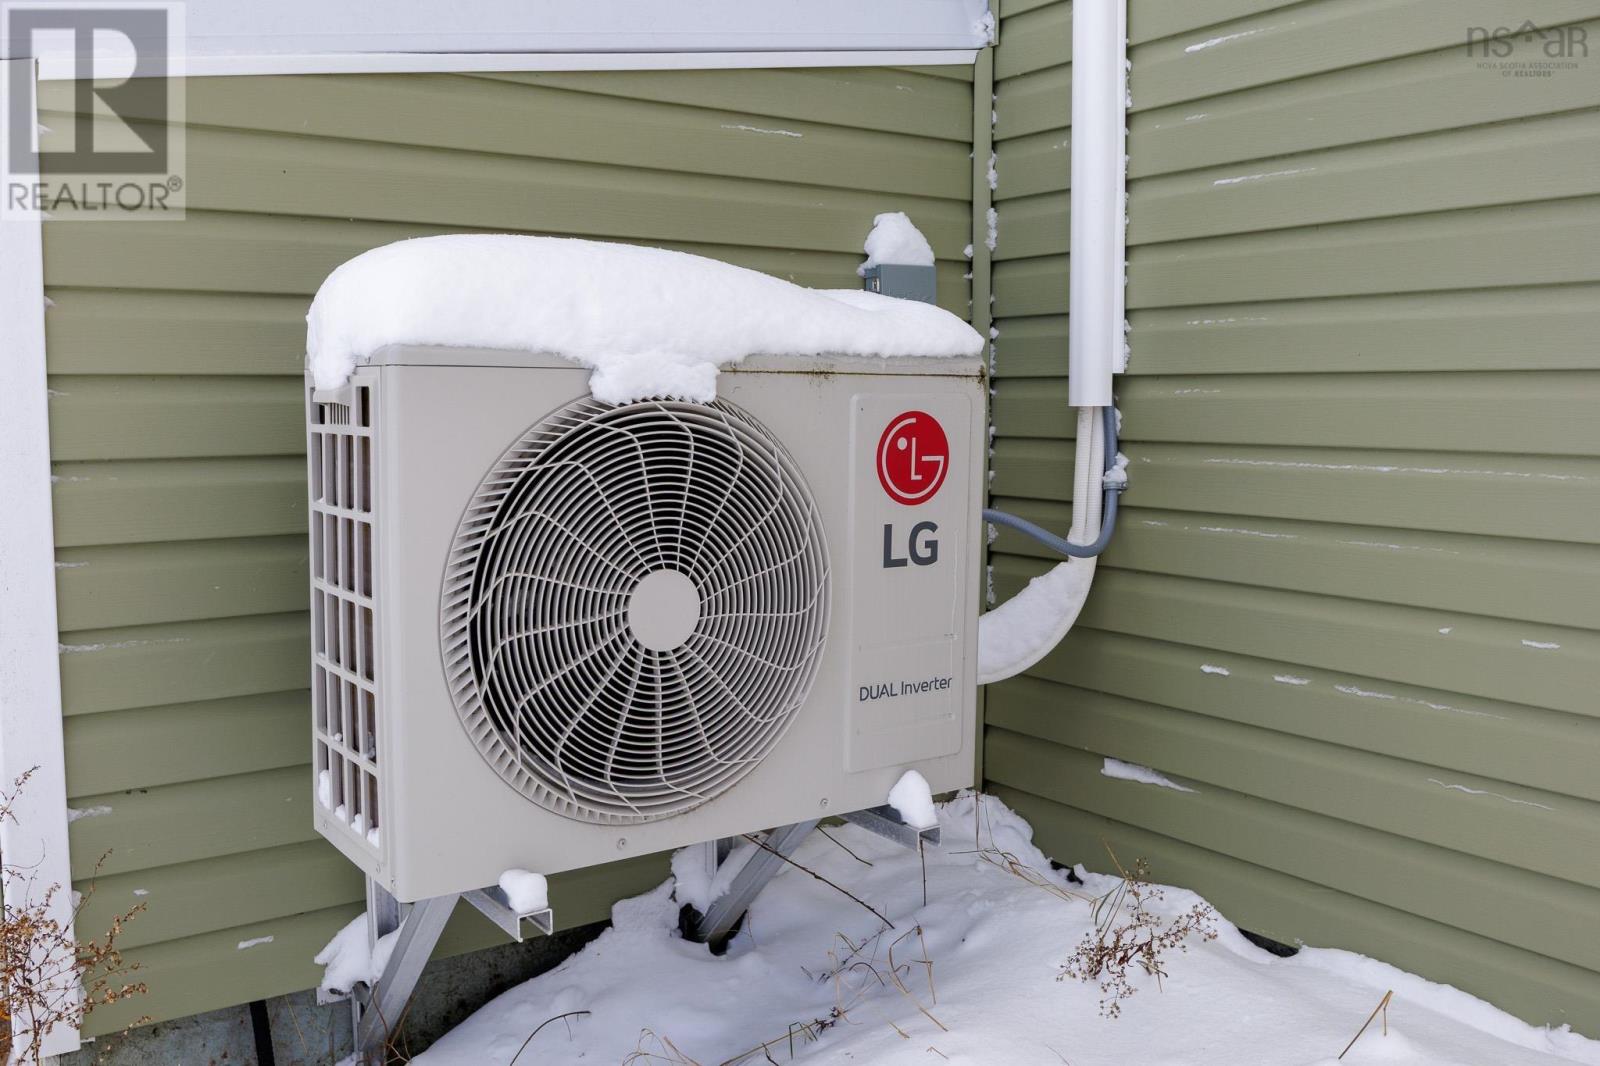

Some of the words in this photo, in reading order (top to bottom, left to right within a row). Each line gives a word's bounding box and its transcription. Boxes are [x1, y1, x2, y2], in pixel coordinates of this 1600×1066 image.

[883, 521, 939, 568] LG
[859, 682, 898, 702] DUAL
[901, 676, 953, 696] Inverter
